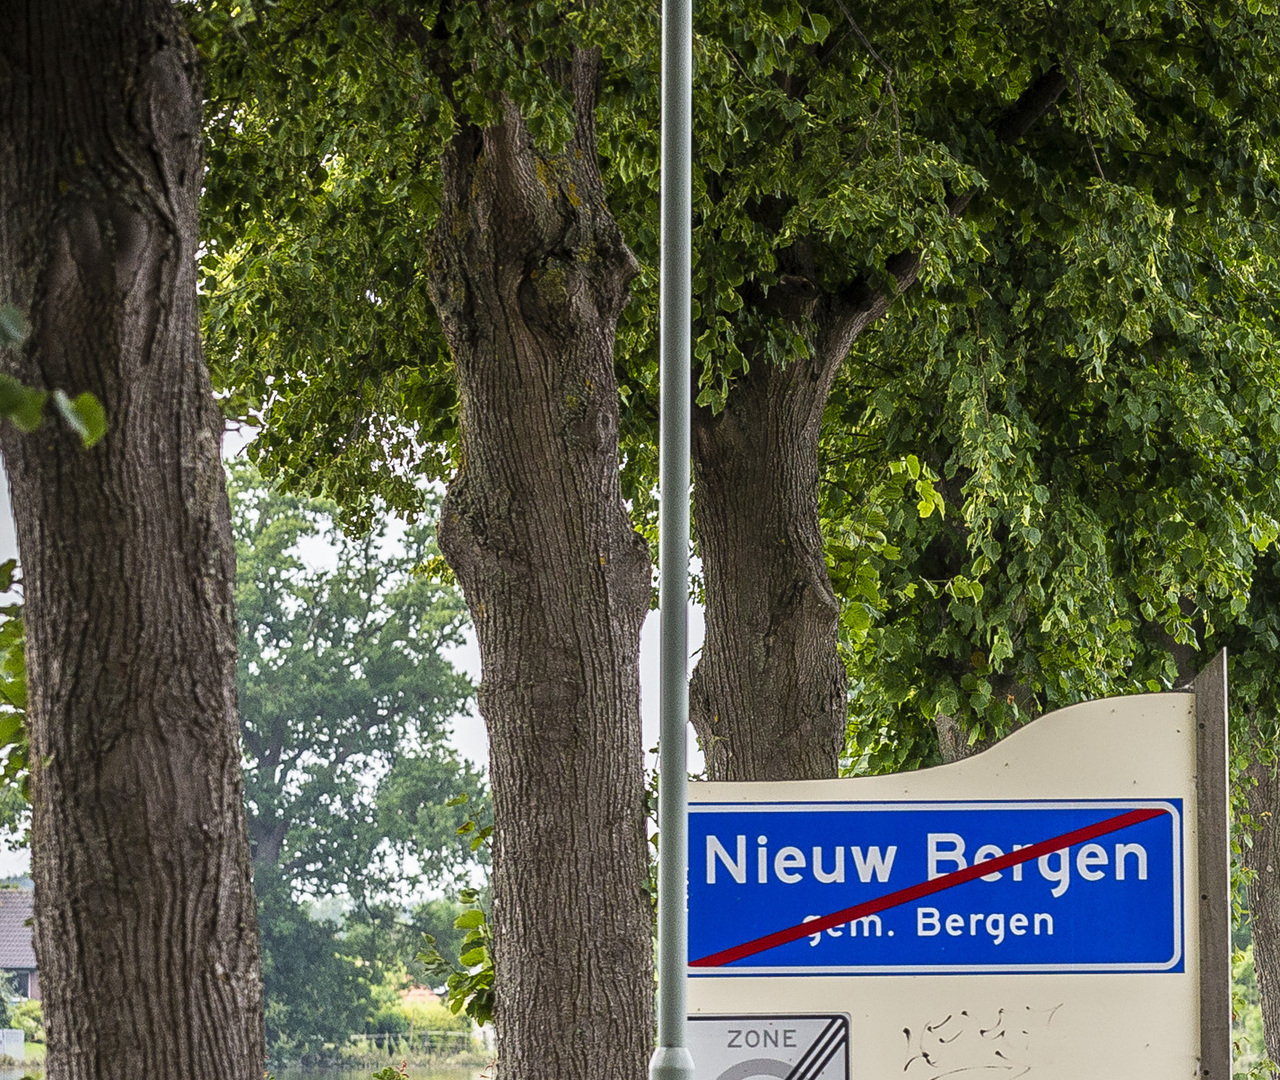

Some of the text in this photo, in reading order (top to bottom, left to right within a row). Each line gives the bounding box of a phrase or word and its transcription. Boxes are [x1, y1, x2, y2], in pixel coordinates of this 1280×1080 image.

[706, 835, 897, 884] Nieuw
[916, 907, 1054, 945] Bergen
[727, 1029, 797, 1049] ZONE
